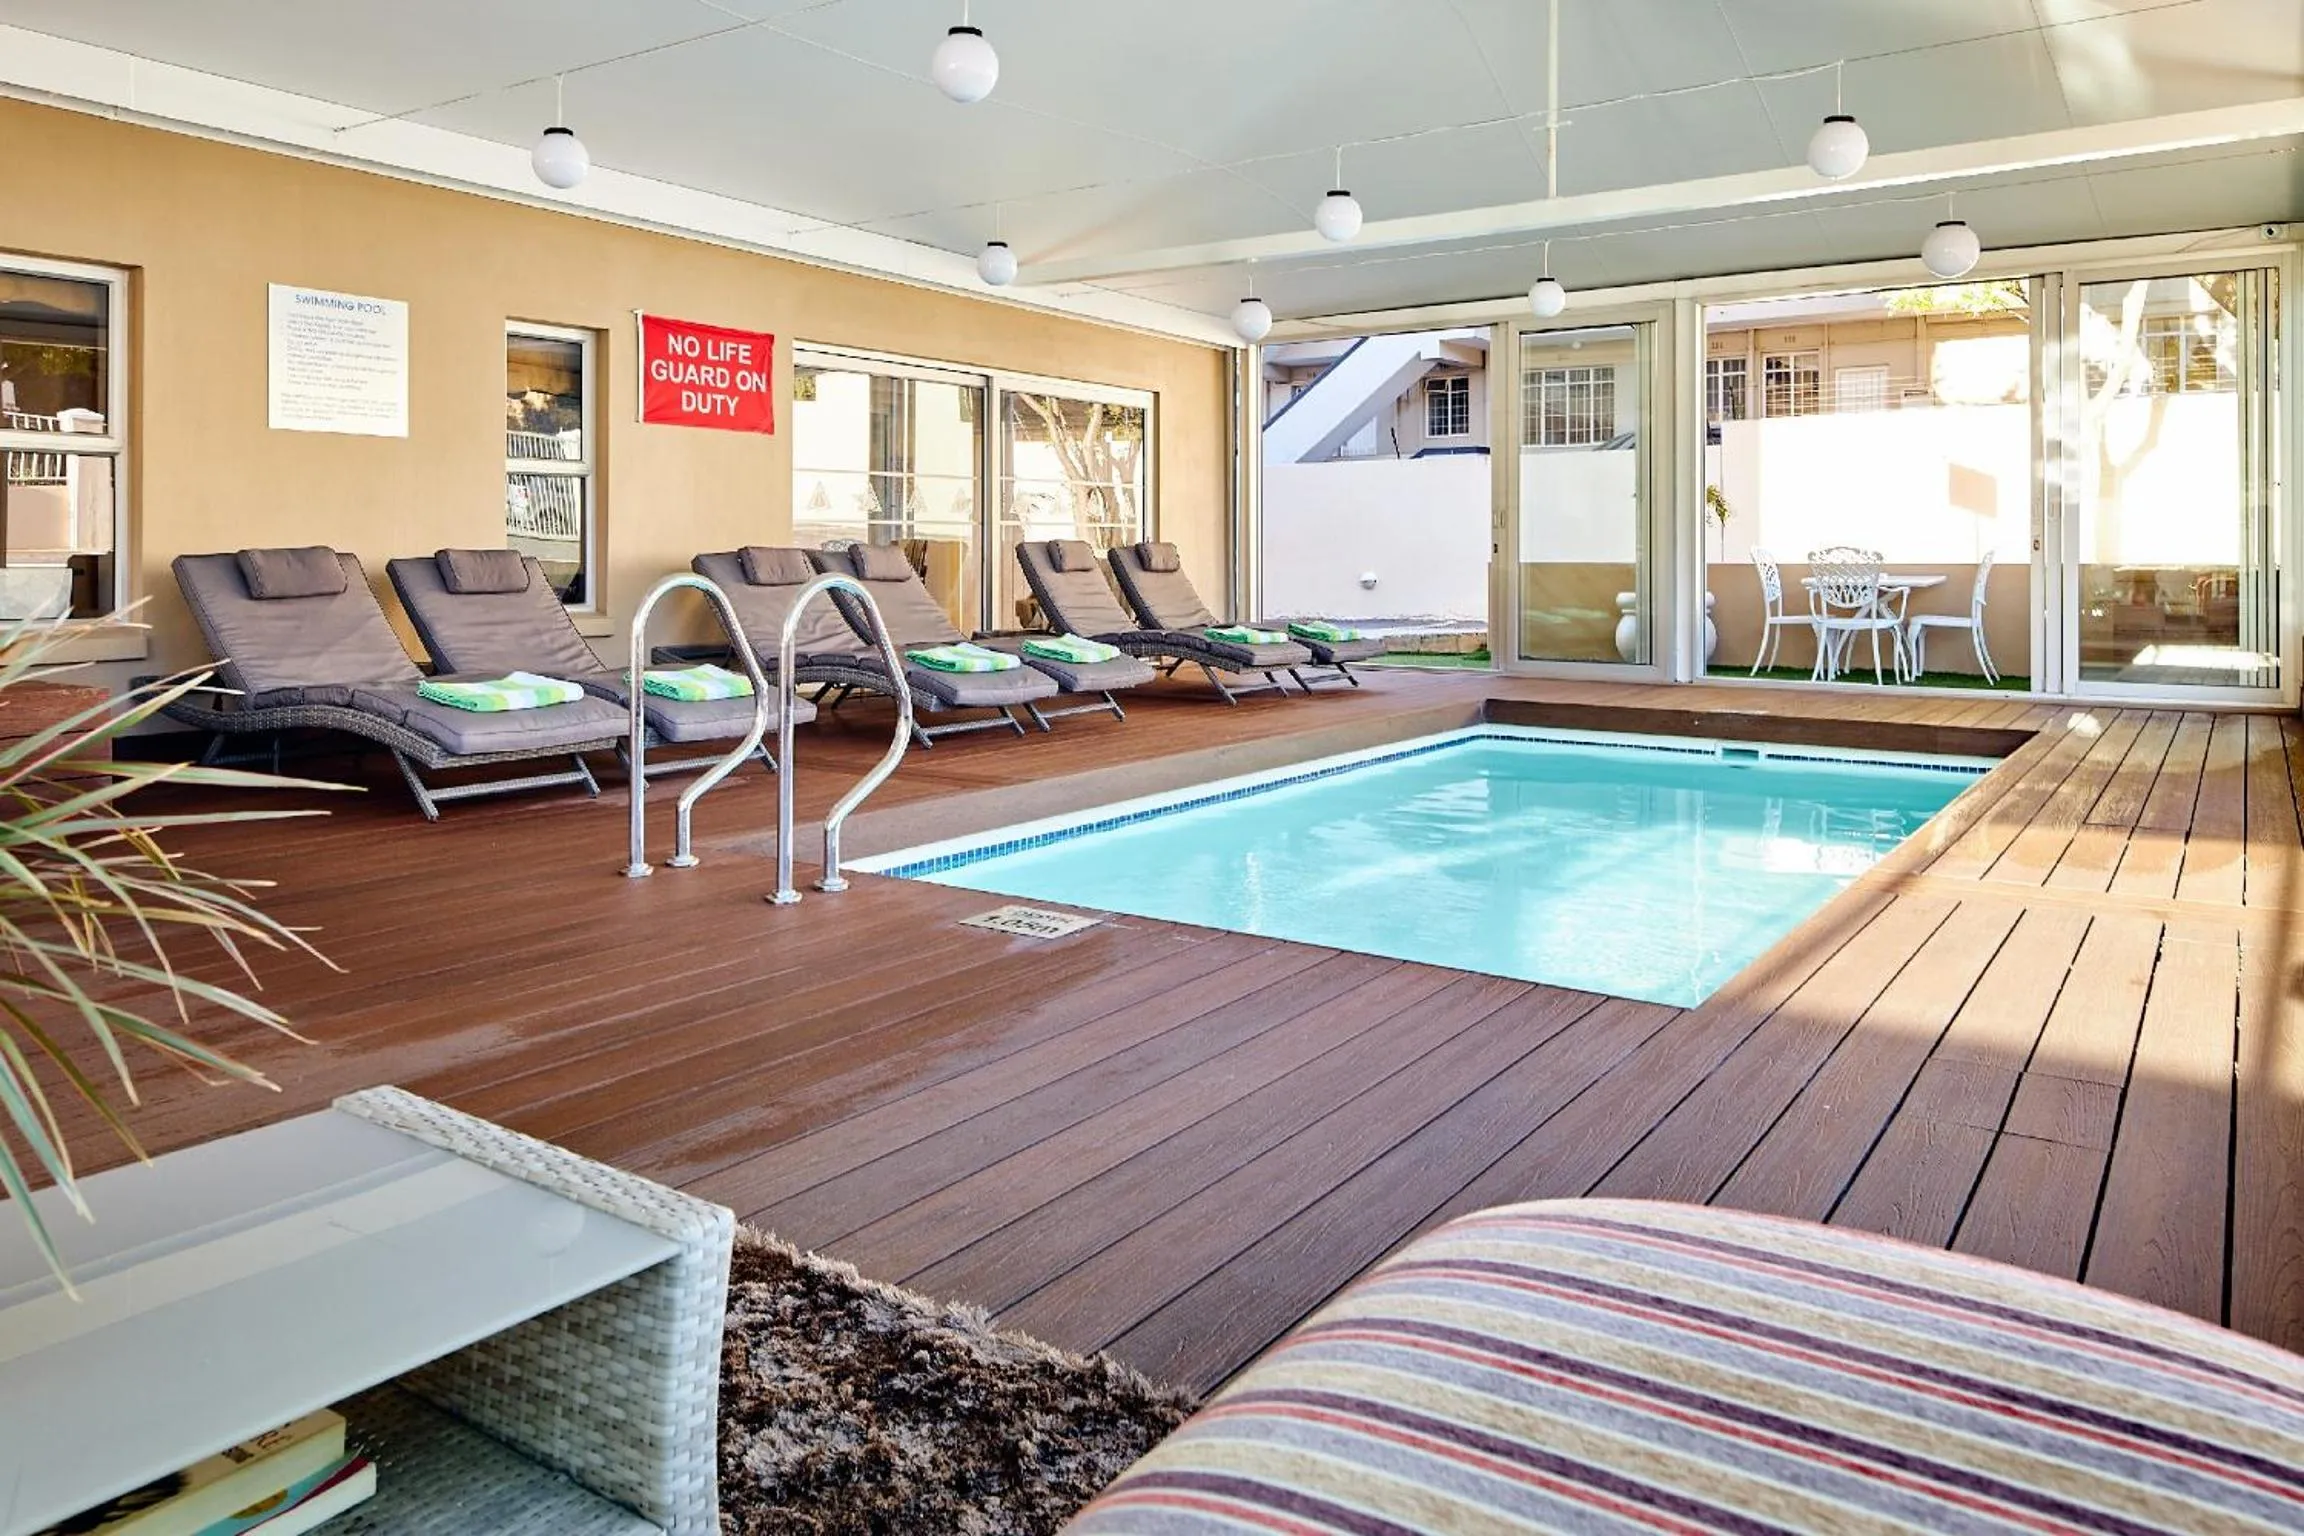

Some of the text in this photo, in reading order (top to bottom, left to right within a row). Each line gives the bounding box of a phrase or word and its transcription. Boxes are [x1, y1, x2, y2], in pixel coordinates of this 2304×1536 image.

[295, 294, 386, 316] SWIMMING POOL
[667, 333, 752, 365] NO LIFE
[650, 359, 767, 393] GUARD ON
[681, 391, 739, 417] DUTY
